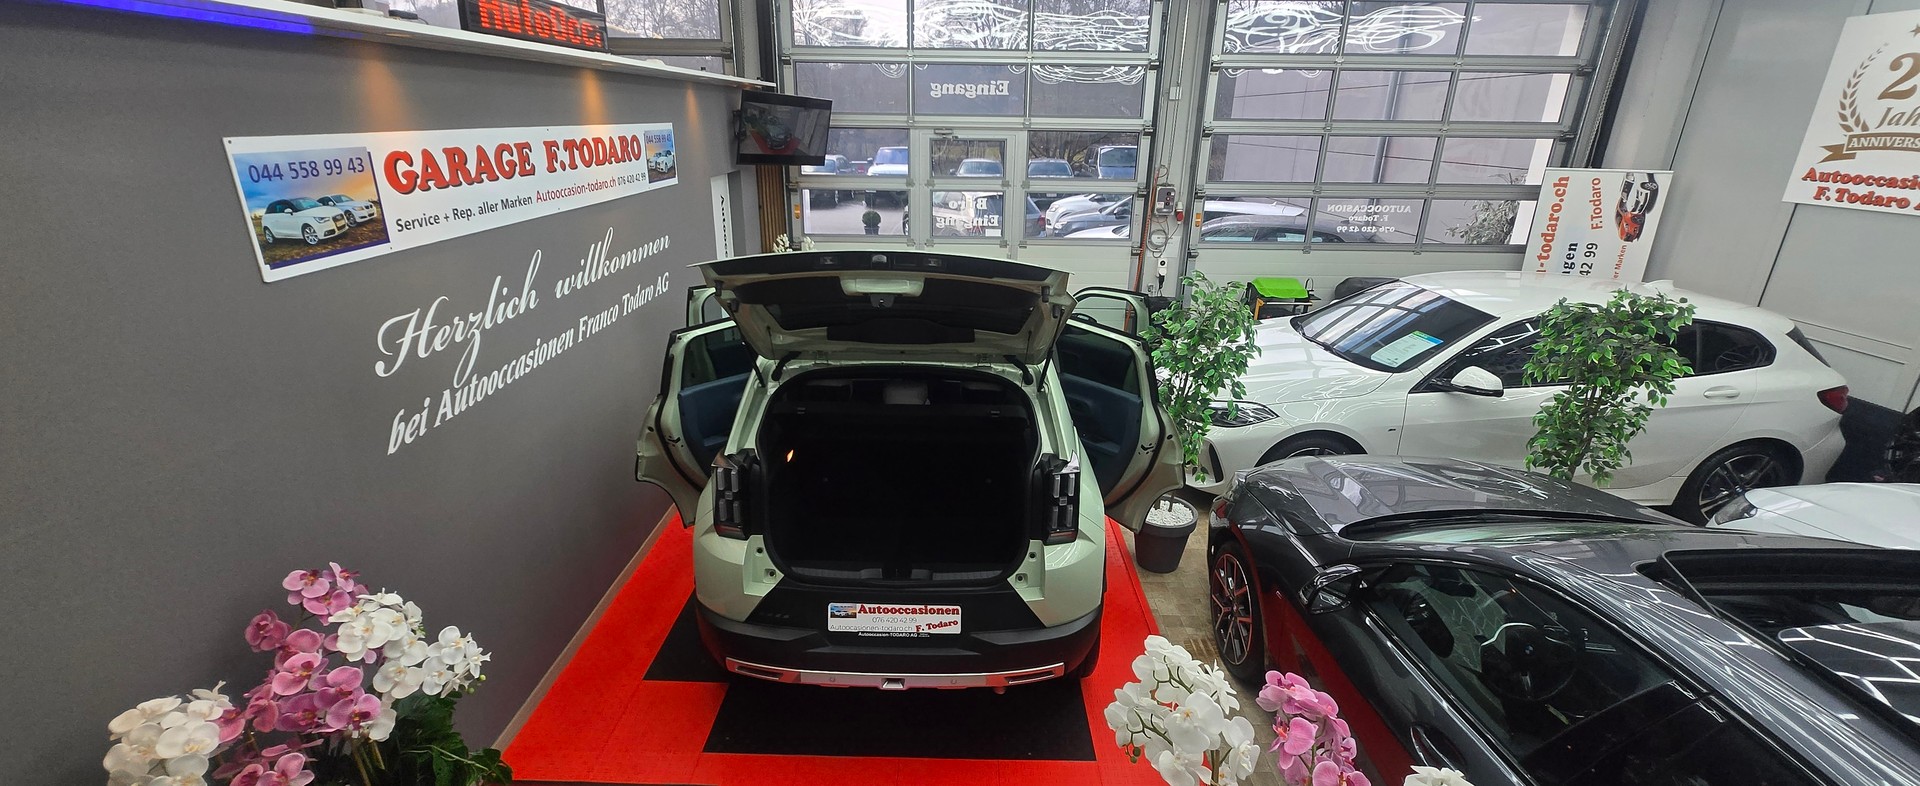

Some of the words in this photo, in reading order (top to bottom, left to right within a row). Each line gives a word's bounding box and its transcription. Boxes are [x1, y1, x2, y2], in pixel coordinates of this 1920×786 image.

[248, 163, 284, 183] 044
[288, 160, 320, 180] 558
[324, 159, 343, 176] 99
[348, 157, 365, 173] 43
[383, 141, 536, 195] GARAGE
[543, 134, 642, 173] F.TODARO
[1802, 167, 1920, 190] Autooccasi
[396, 213, 440, 232] Service
[451, 208, 476, 221] Rep.
[478, 201, 499, 215] aller
[500, 195, 533, 211] Marken
[536, 177, 616, 203] Autooccasion-todaro.ch
[617, 176, 626, 186] 076
[627, 174, 635, 184] 420
[635, 173, 641, 182] 42
[641, 172, 646, 181] 99
[1813, 186, 1831, 202] F.
[1835, 187, 1911, 209] Todaro
[1586, 242, 1599, 258] 99
[1615, 244, 1627, 269] Marken
[375, 249, 542, 389] Herzlich
[555, 226, 670, 298] willkommen
[387, 397, 430, 455] bei
[433, 328, 574, 428] Autooccasionen
[578, 304, 619, 343] Franco
[622, 284, 654, 317] Todaro
[655, 272, 670, 297] AG
[857, 604, 960, 615] Autooccasionen
[915, 624, 925, 632] F.
[926, 620, 959, 630] Todaro
